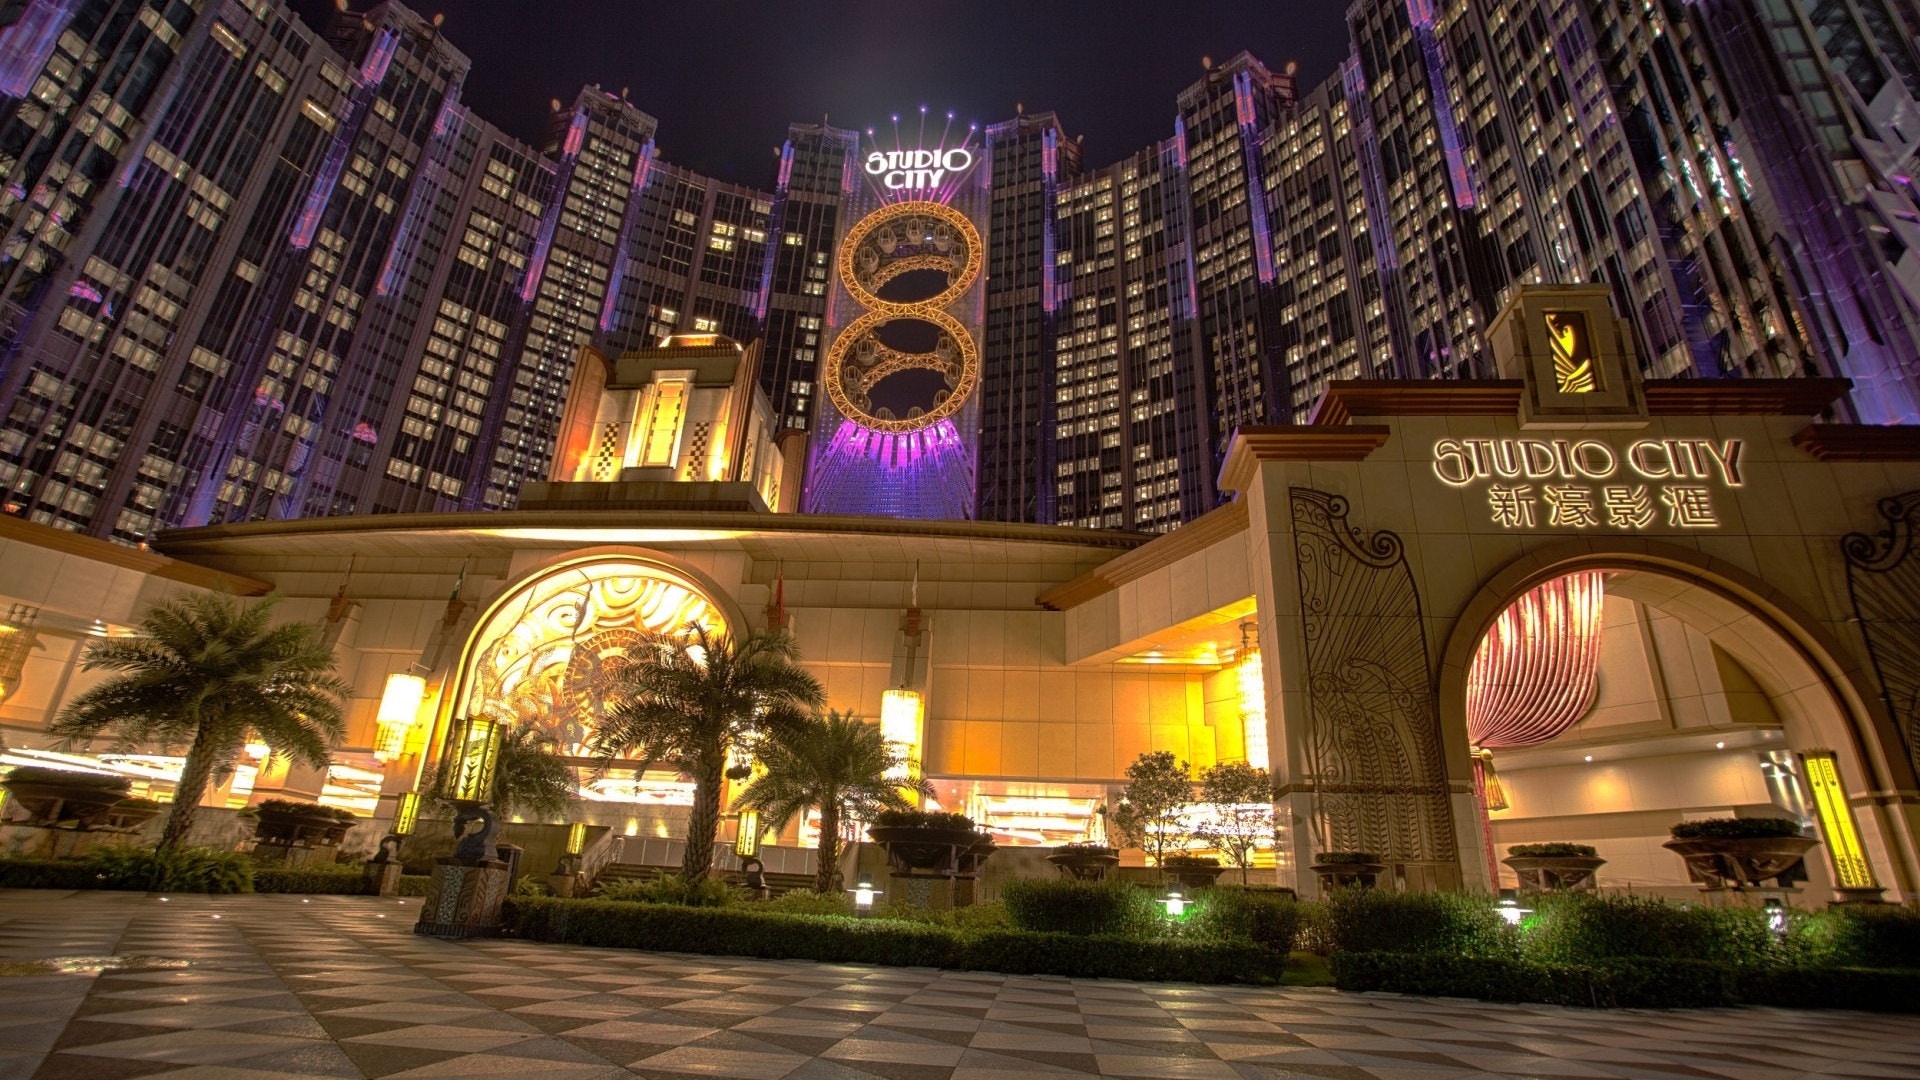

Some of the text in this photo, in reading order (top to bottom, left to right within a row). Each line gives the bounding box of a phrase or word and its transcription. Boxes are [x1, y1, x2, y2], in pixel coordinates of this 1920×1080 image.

[865, 149, 972, 175] STUDIO
[884, 168, 945, 190] CITY
[1432, 438, 1745, 487] STUDIO CITY
